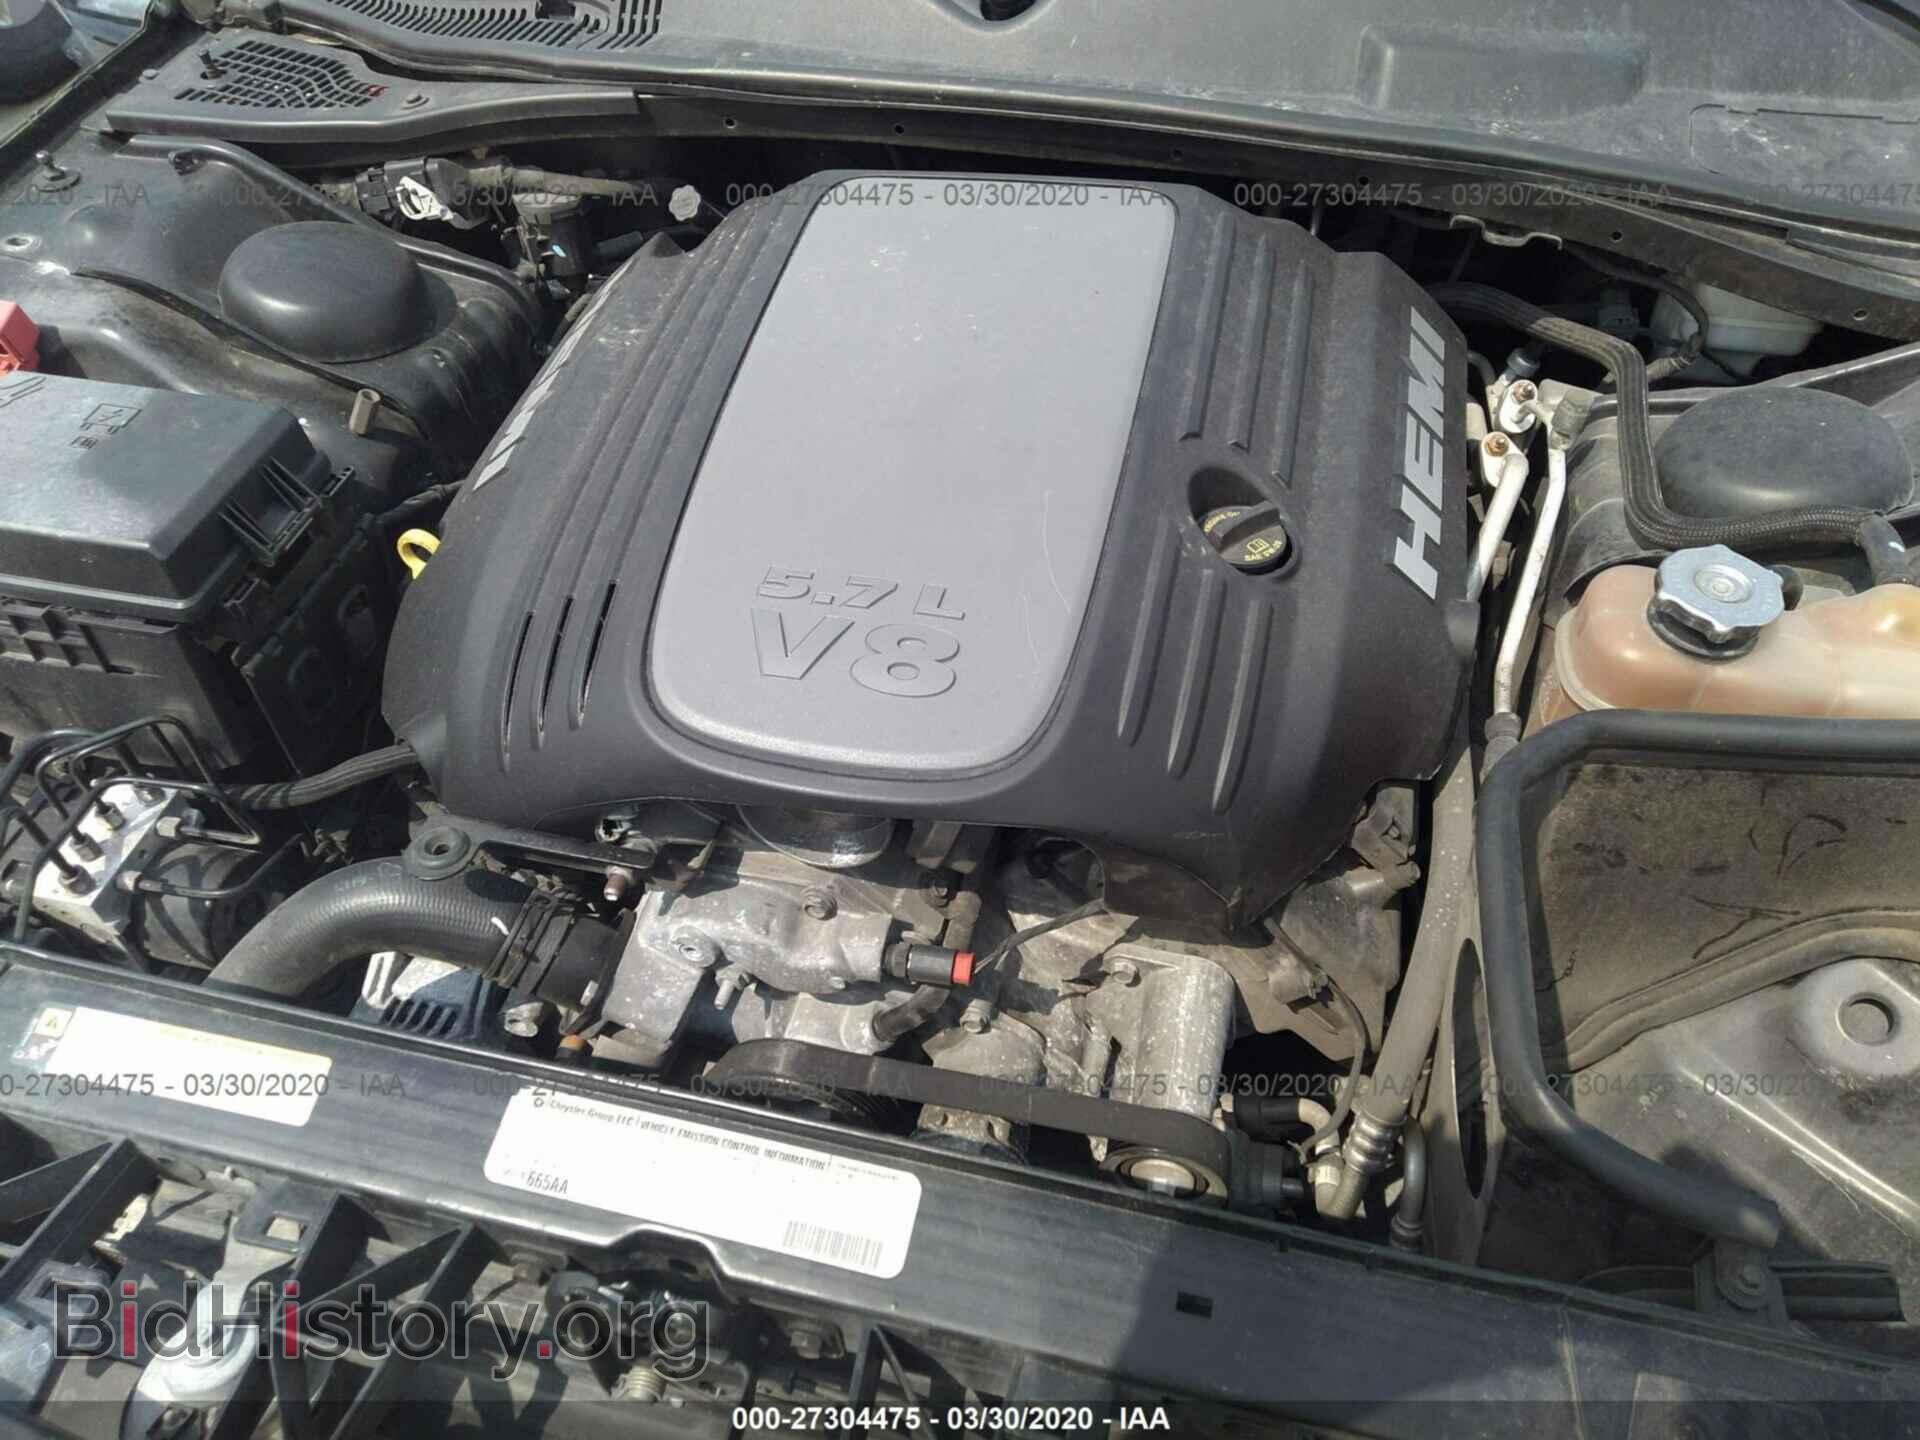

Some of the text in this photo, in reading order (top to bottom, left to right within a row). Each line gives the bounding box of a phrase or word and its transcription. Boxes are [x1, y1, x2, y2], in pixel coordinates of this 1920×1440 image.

[1393, 306, 1445, 600] HEMI
[750, 607, 961, 698] V8
[677, 1128, 719, 1146] EMISSION
[720, 1137, 760, 1157] CONTROL
[763, 1148, 826, 1171] INFORMATION
